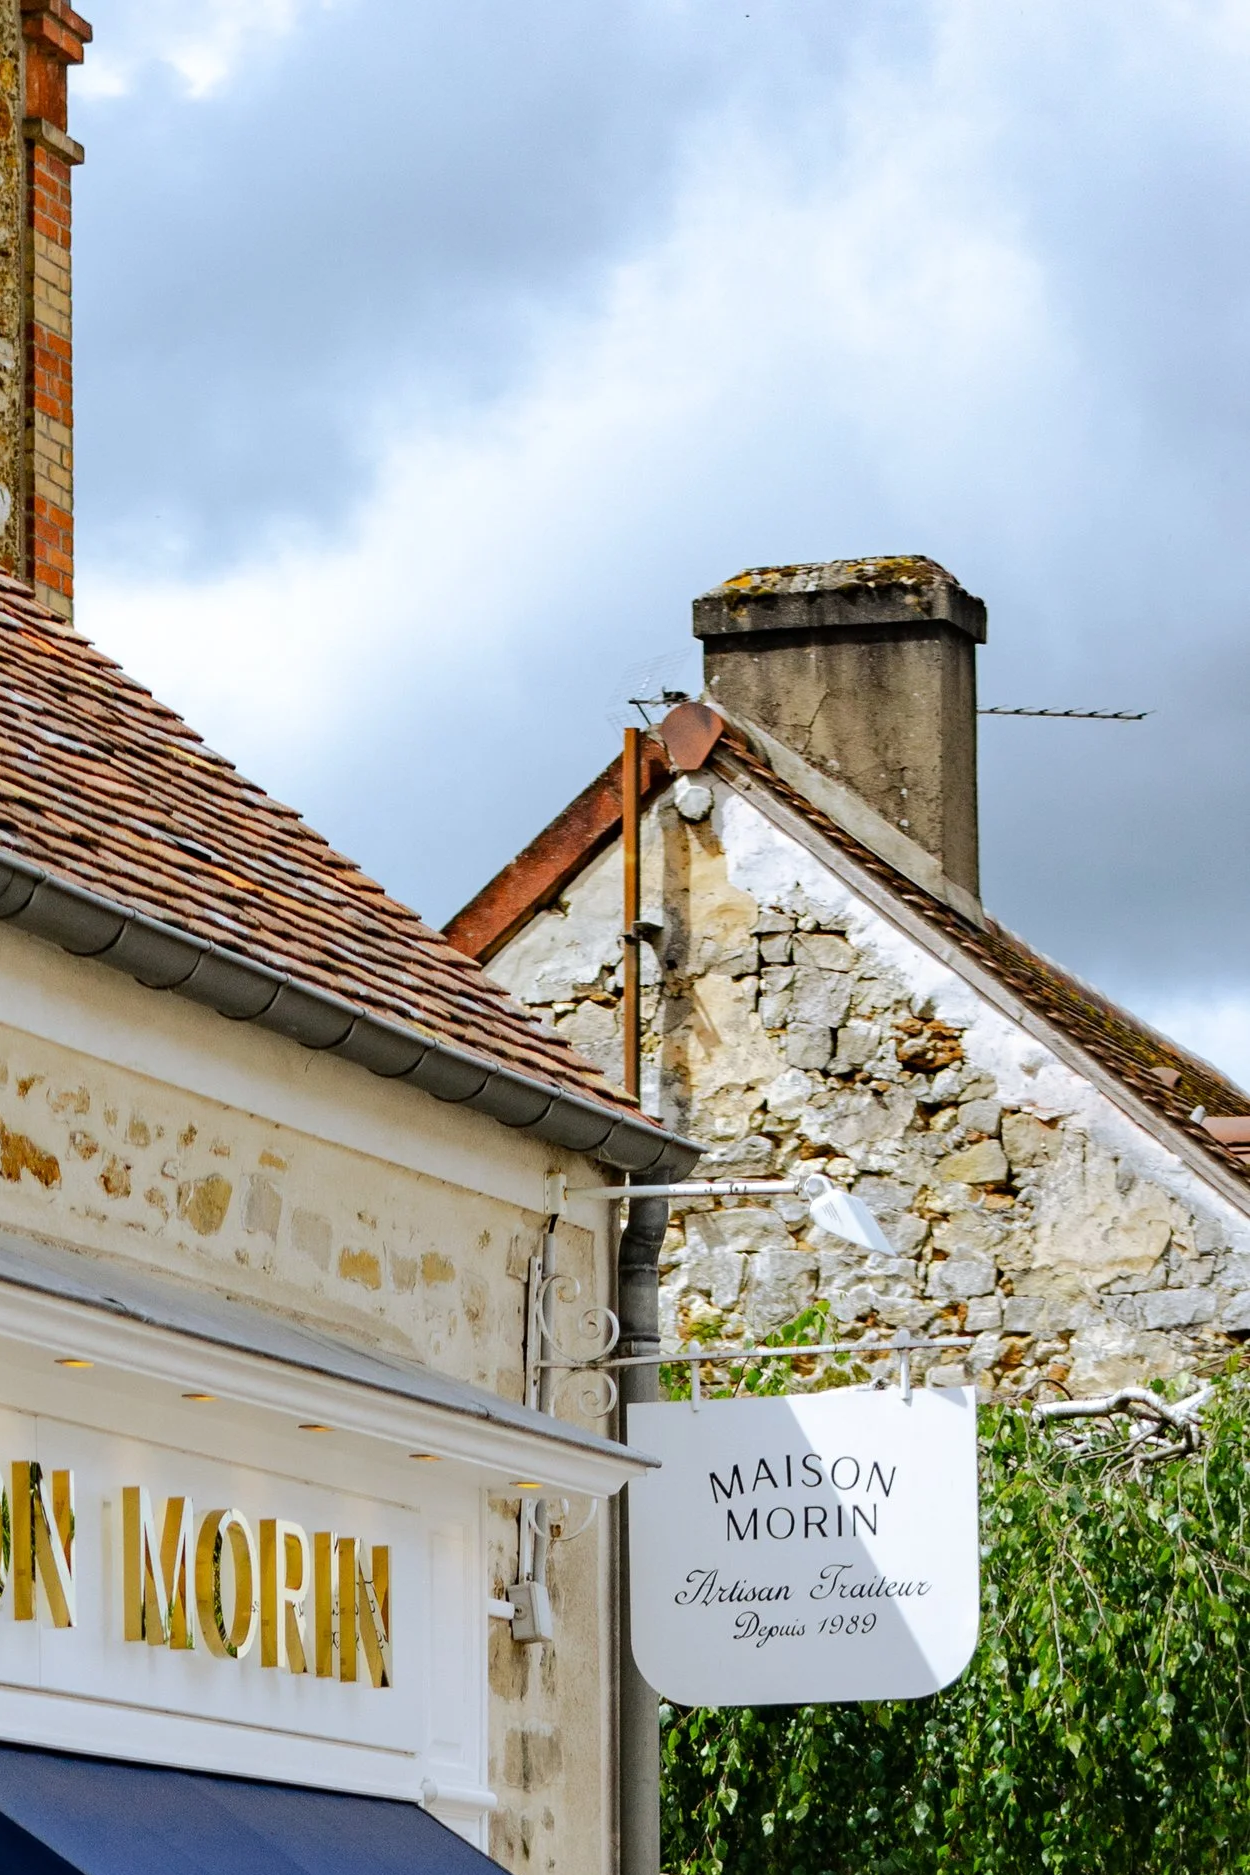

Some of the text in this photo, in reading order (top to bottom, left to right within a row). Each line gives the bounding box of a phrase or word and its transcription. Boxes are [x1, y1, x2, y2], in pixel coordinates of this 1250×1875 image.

[709, 1453, 897, 1504] MAISON
[726, 1503, 878, 1542] MORIN
[123, 1486, 393, 1688] MORIN
[674, 1564, 932, 1607] Artisan Traiteur
[733, 1611, 877, 1649] Depuis 1989
